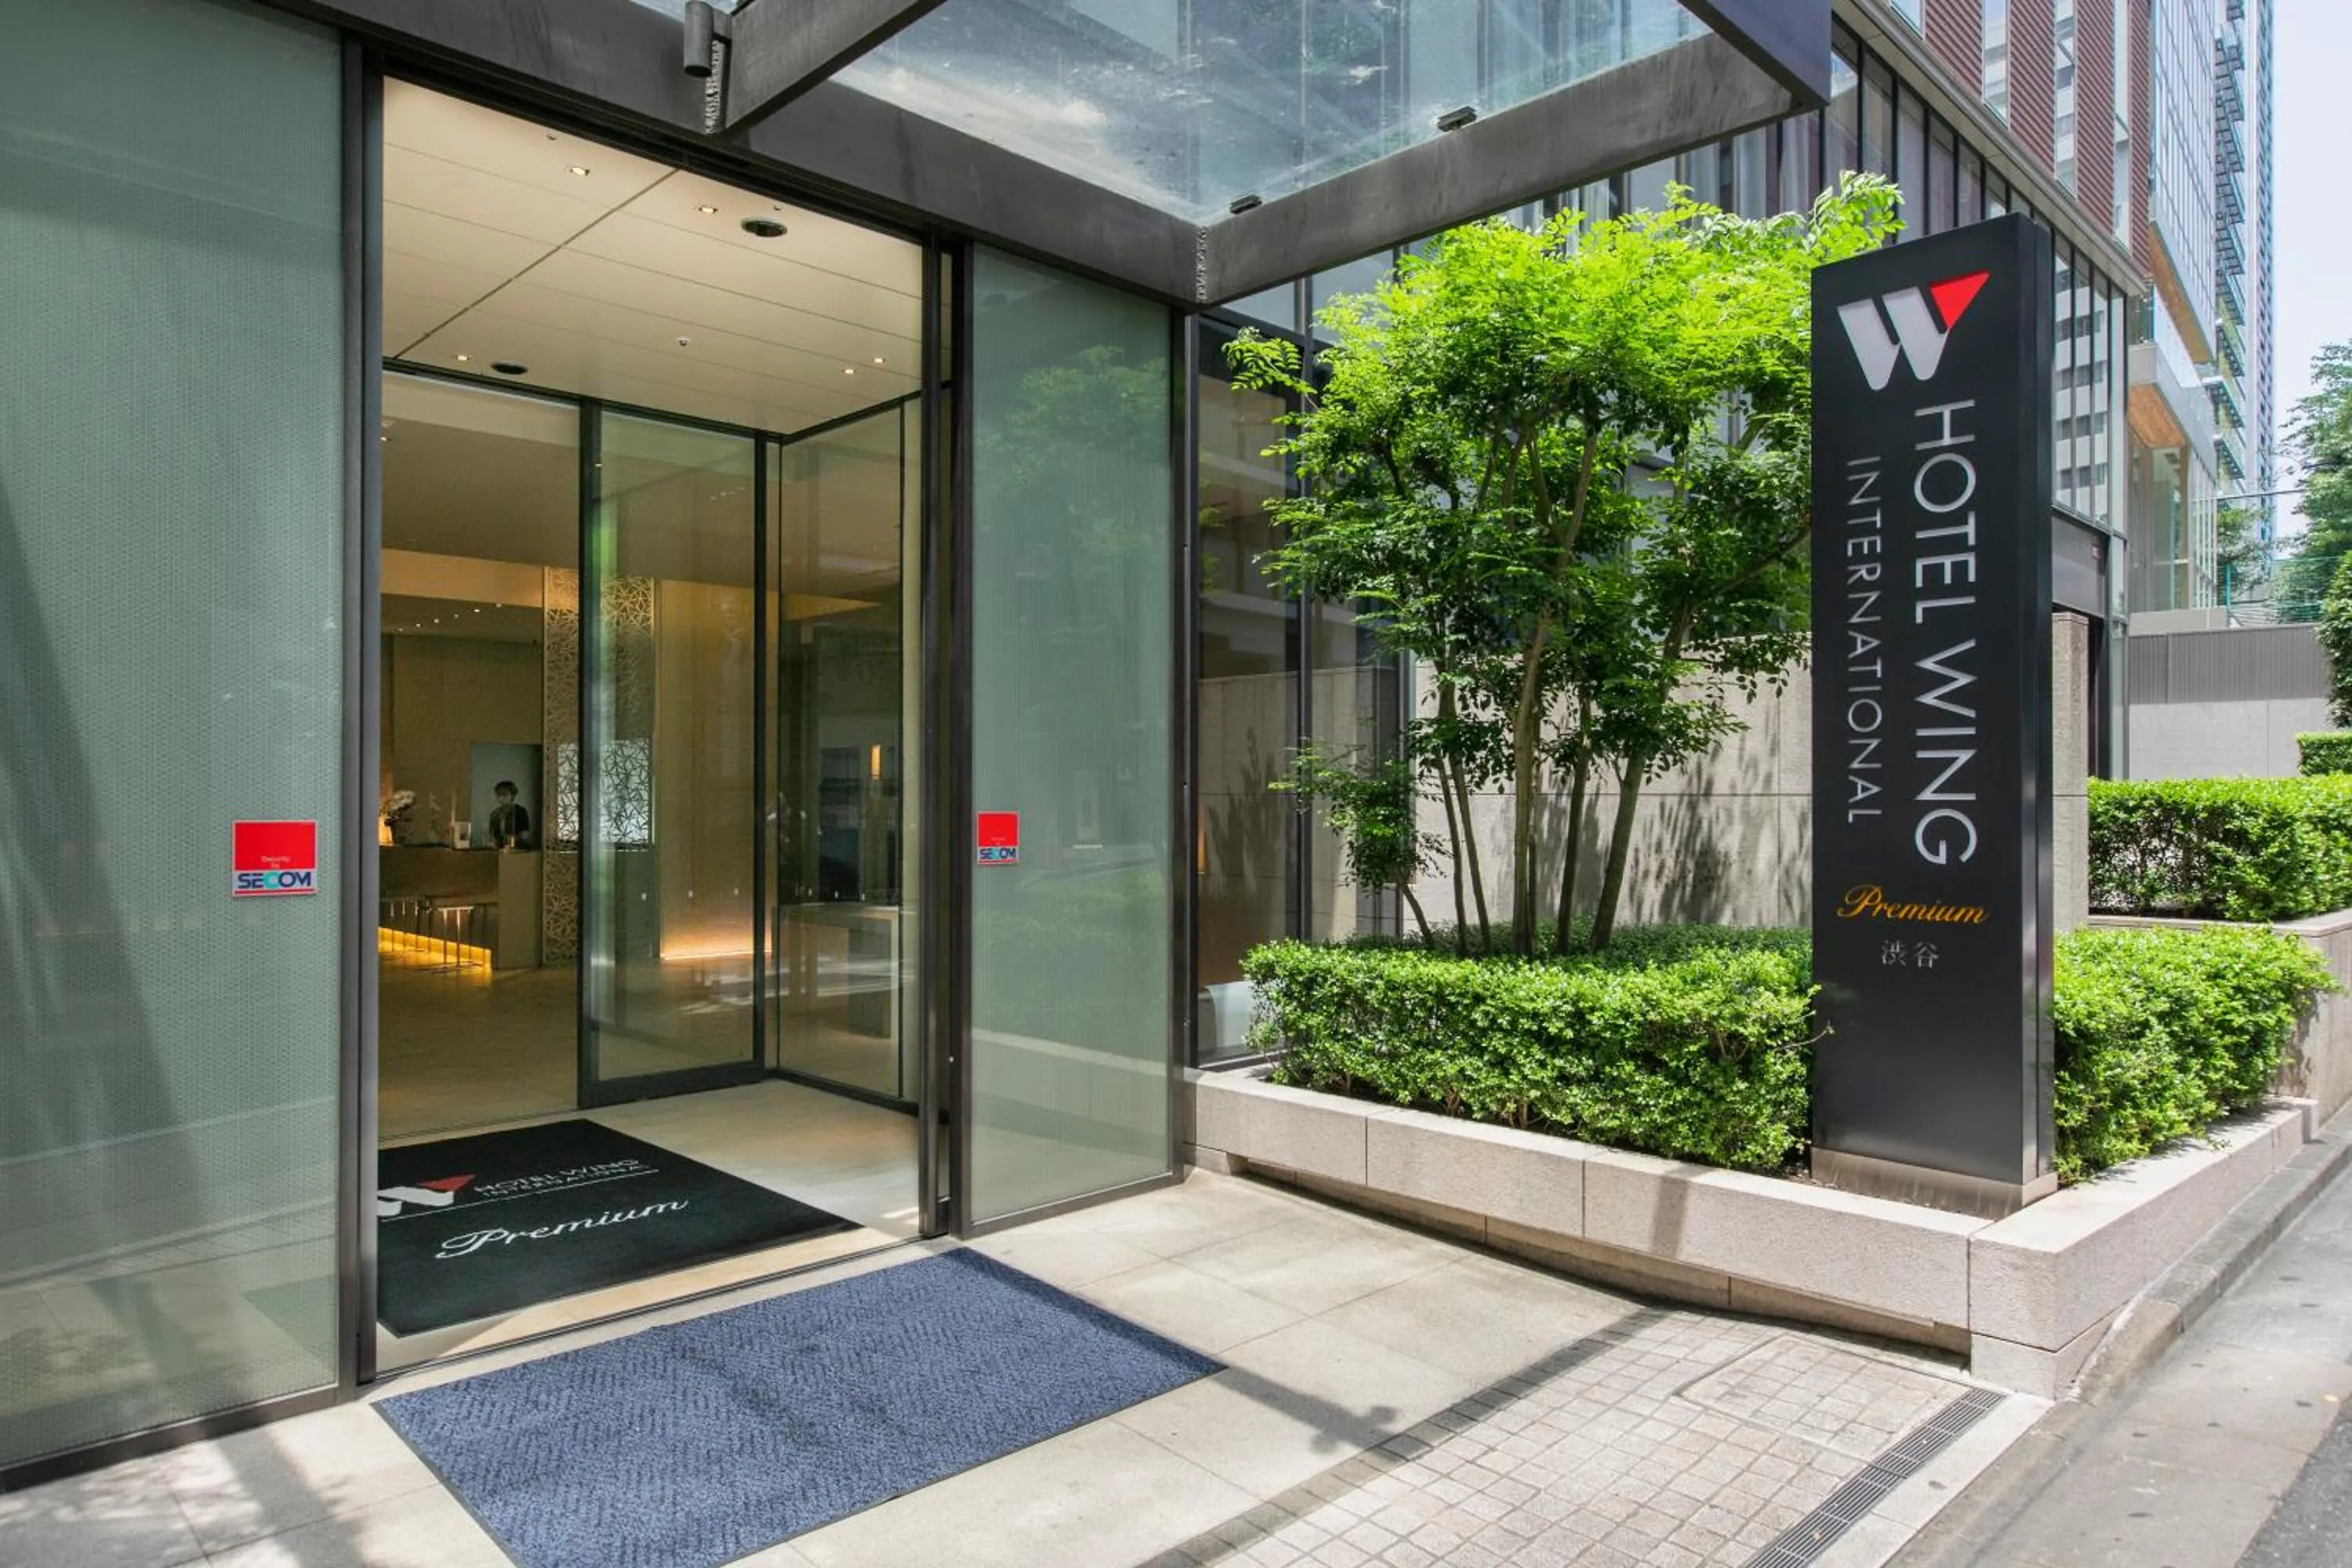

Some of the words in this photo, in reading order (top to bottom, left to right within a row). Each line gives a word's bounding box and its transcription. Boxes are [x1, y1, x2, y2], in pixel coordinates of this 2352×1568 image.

[1914, 399, 1976, 624] HOTEL
[1847, 456, 1882, 823] INTERNATIONAL
[1914, 638, 1978, 865] WING
[238, 872, 311, 889] SECOM
[1836, 884, 1989, 924] Premium
[1882, 941, 1939, 969] 渋谷
[435, 1200, 688, 1258] Premium
